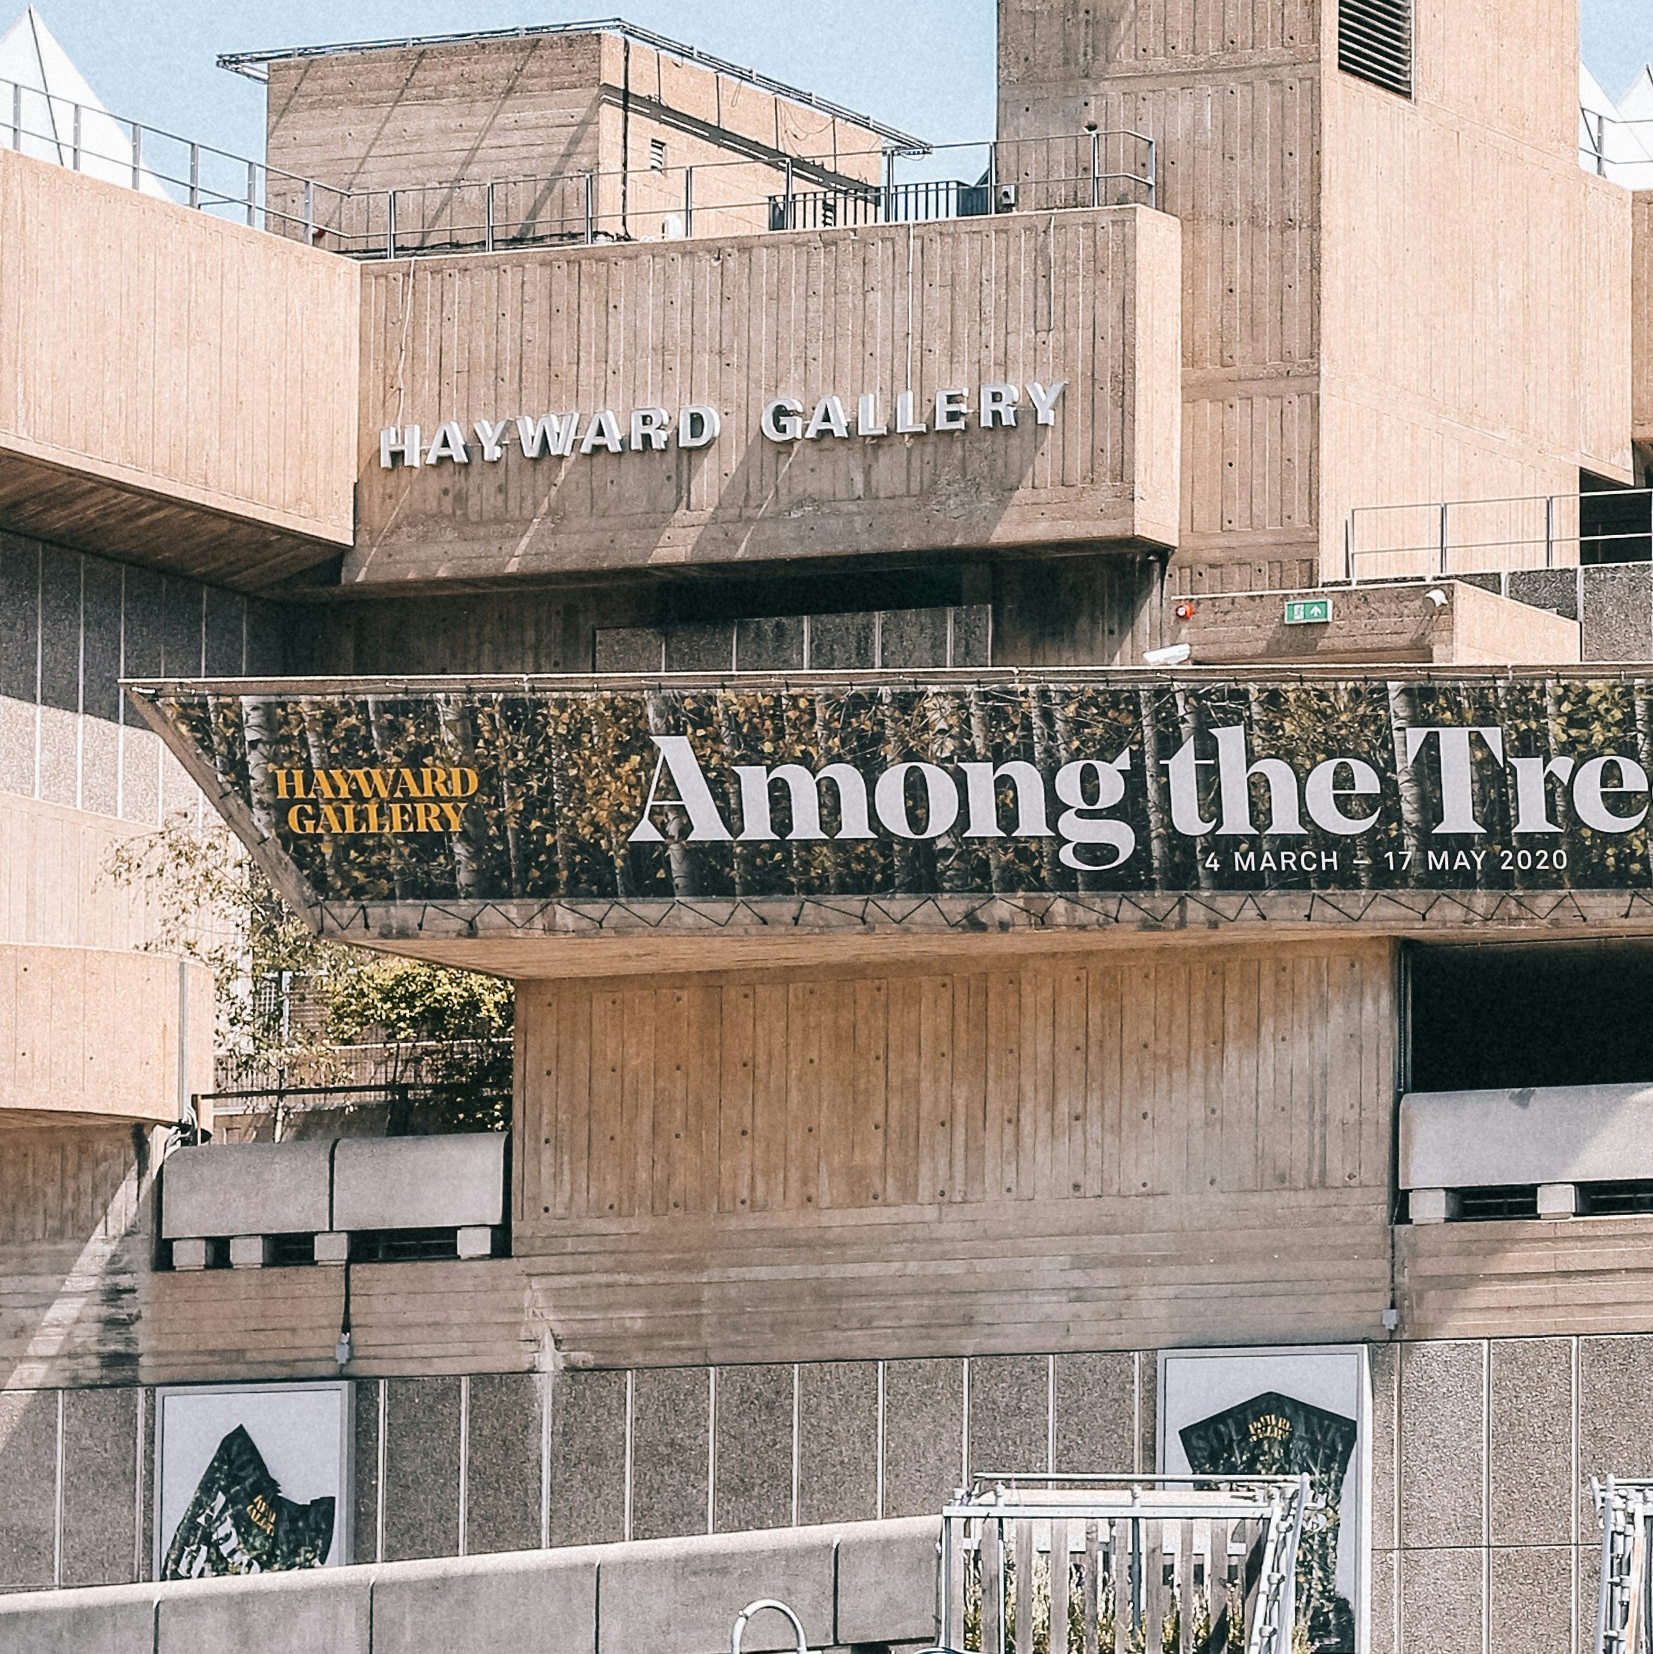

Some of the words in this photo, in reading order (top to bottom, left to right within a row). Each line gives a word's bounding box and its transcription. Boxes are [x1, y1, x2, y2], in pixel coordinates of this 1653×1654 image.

[379, 404, 721, 469] HAYWARD
[760, 380, 1069, 443] GALLERY
[273, 765, 480, 800] HAYWARD
[627, 734, 1137, 871] Among
[1159, 726, 1382, 836] the
[285, 800, 468, 835] GALLERY
[1203, 850, 1221, 872] 4
[1233, 849, 1340, 873] MARCH
[1383, 849, 1411, 871] 17
[1427, 849, 1487, 871] MAY
[1499, 848, 1568, 871] 2020
